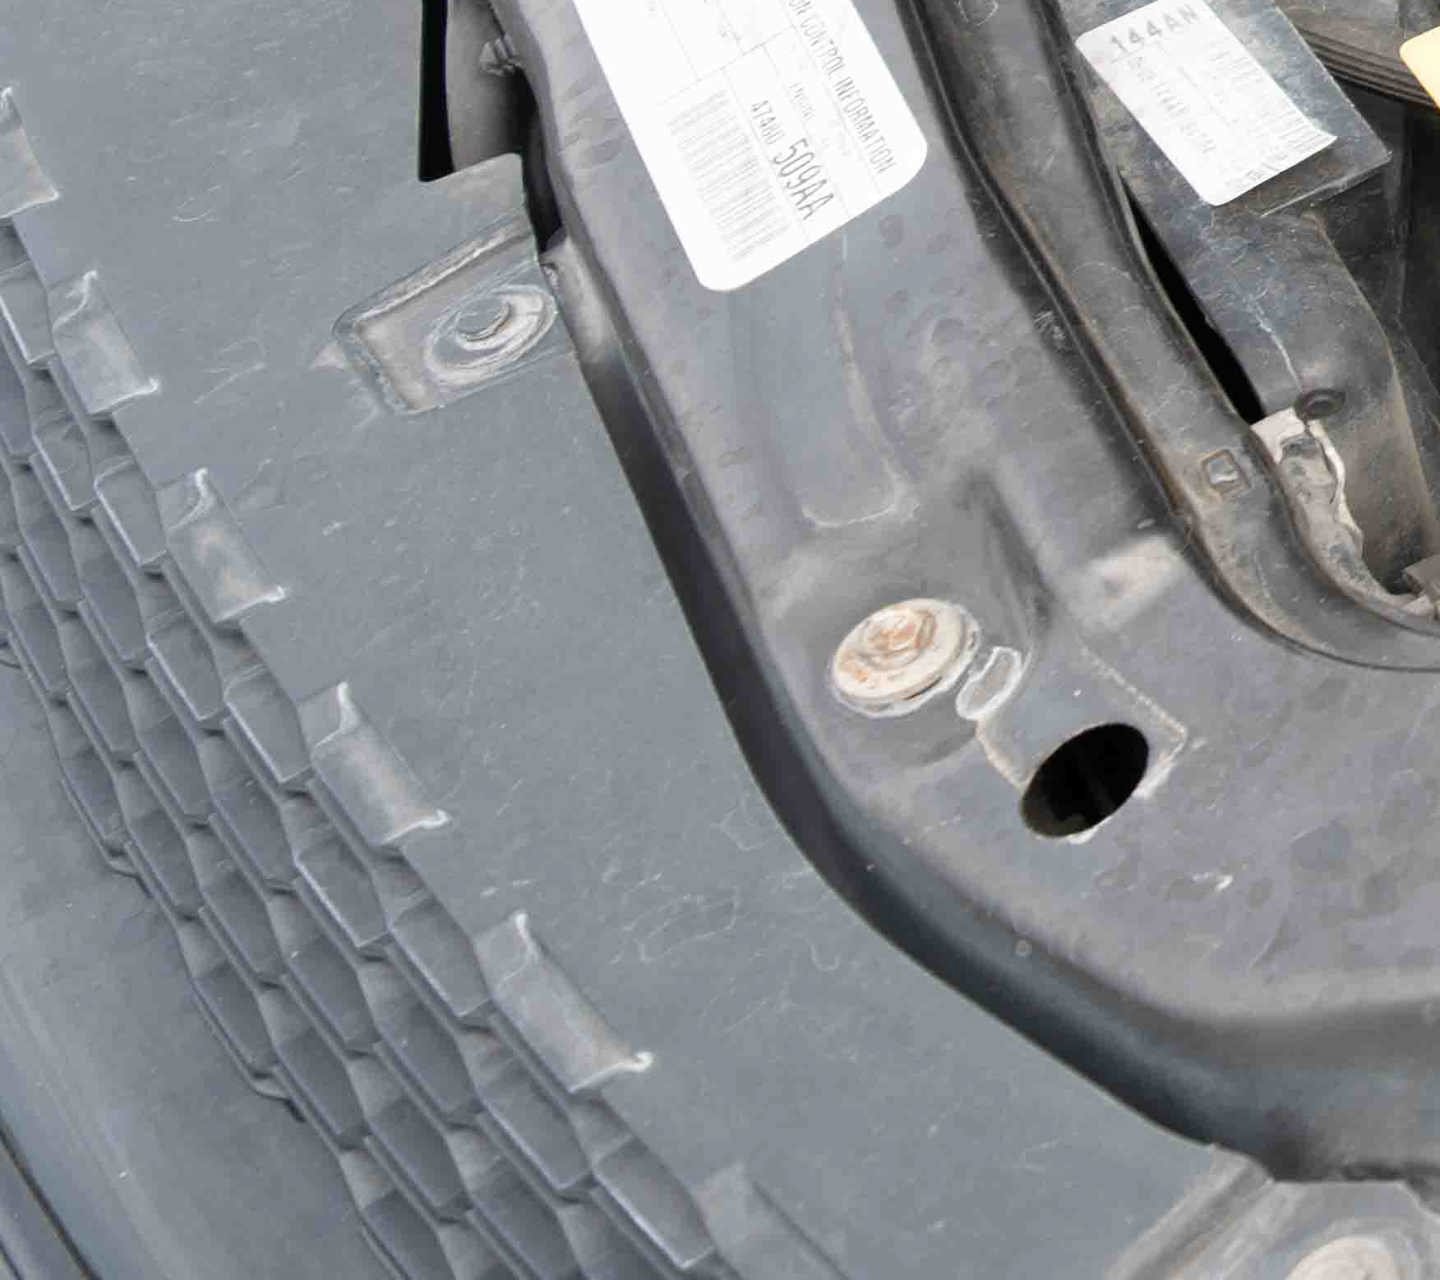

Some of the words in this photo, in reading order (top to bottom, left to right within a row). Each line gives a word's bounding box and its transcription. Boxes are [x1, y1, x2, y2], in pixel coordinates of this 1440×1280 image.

[798, 11, 848, 78] CONTROL
[831, 73, 899, 175] INFORMATION
[769, 136, 838, 222] 509AA
